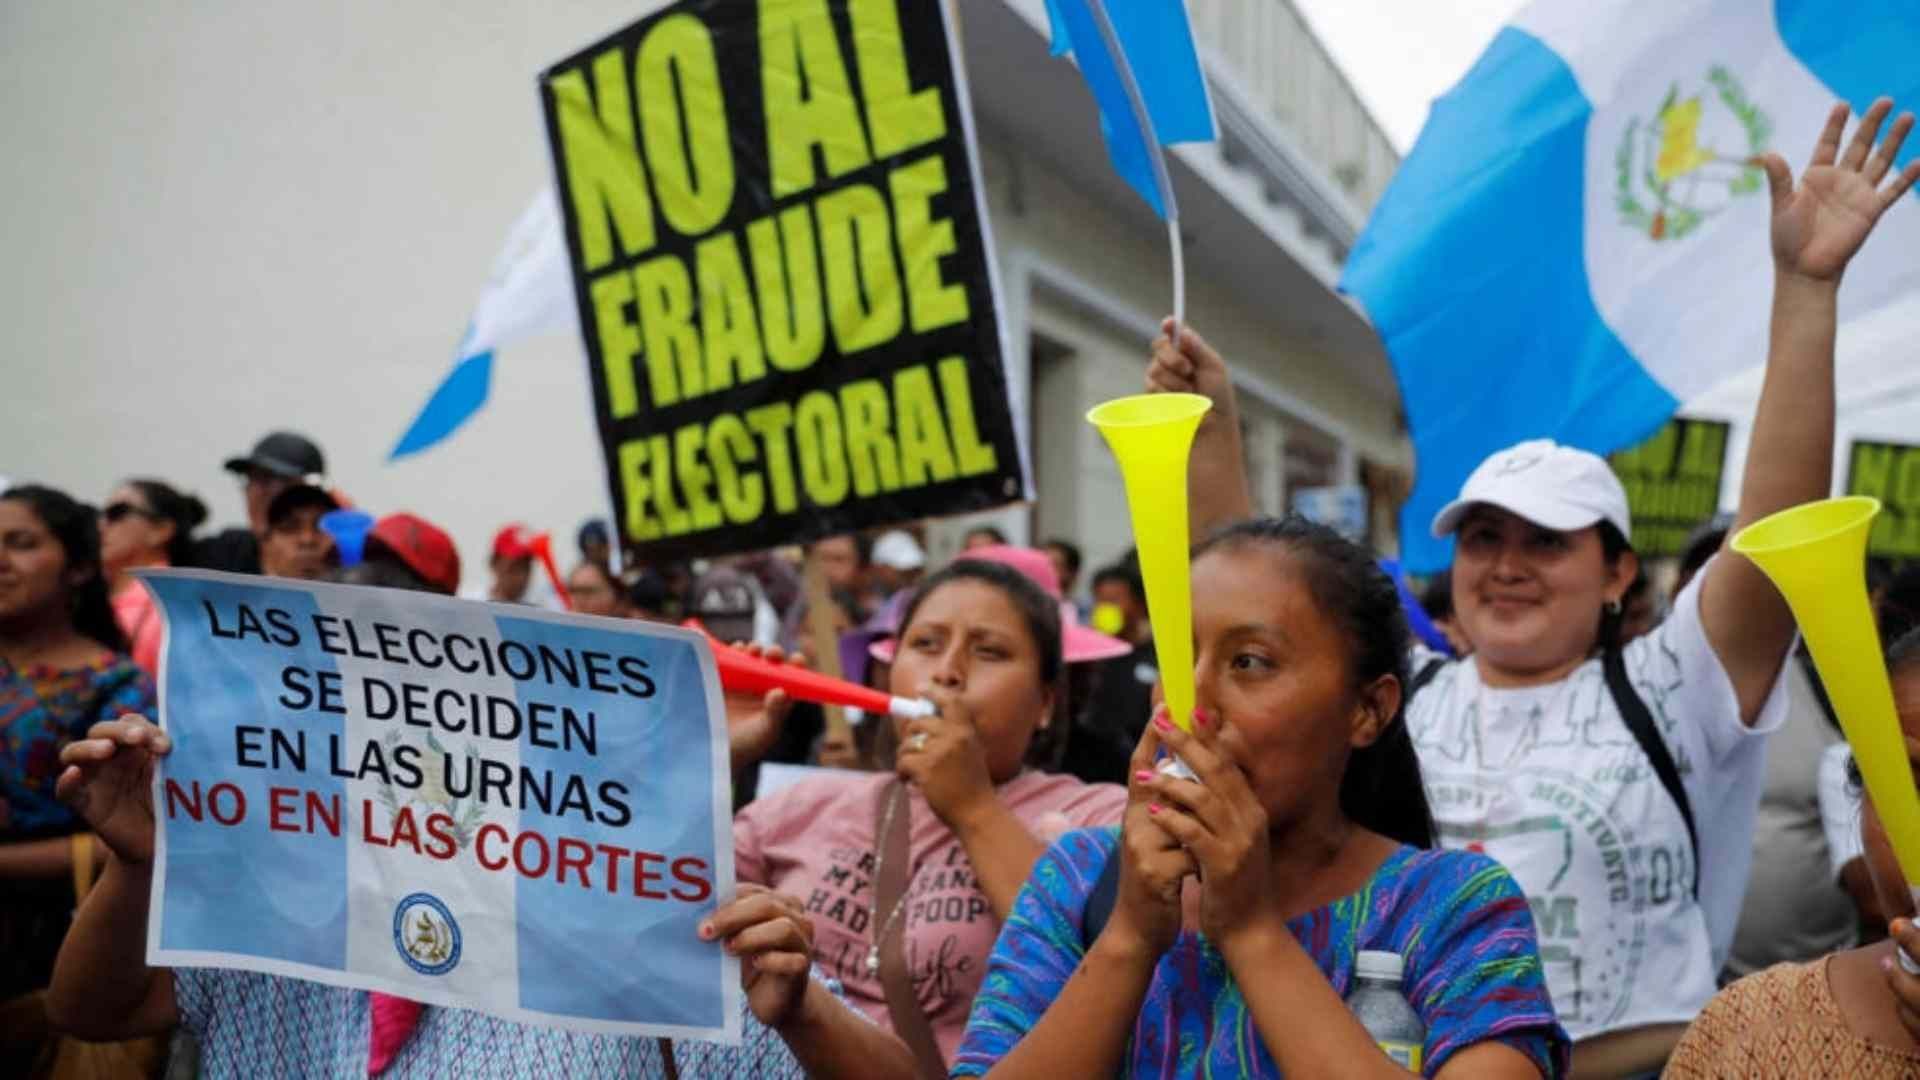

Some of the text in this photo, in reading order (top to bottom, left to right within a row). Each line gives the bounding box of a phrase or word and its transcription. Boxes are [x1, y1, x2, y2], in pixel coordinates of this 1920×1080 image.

[550, 0, 947, 271] NO AL
[590, 154, 970, 419] FRAUDE
[618, 356, 997, 541] ELECTORAL
[202, 600, 657, 699] LAS ELECCIONES
[278, 666, 598, 756] SE DECIDEN
[235, 725, 632, 828] EN LAS URNAS
[165, 778, 712, 901] NO EN LAS CORTES
[823, 865, 869, 897] MY
[806, 889, 870, 934] HAD
